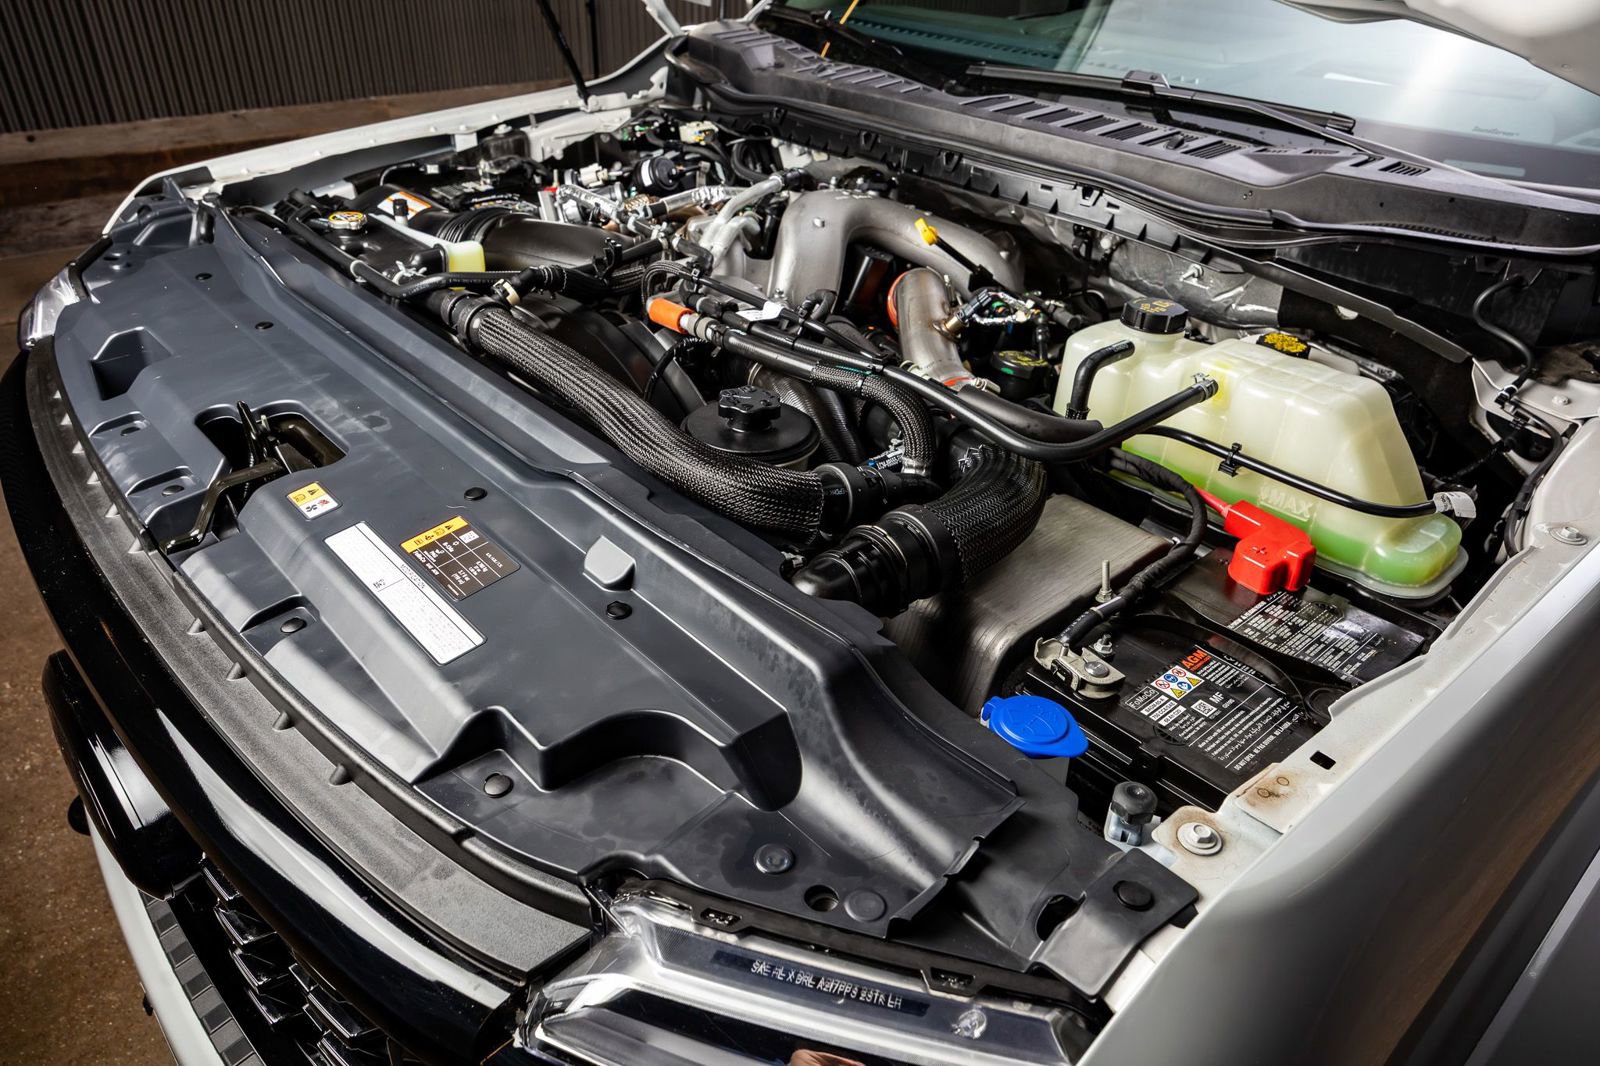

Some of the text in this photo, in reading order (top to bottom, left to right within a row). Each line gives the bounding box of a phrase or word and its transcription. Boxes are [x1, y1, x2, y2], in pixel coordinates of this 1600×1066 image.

[1269, 488, 1311, 519] MAX
[1181, 649, 1208, 669] AGM
[1127, 688, 1156, 709] FoMoCo
[1209, 691, 1225, 704] MF
